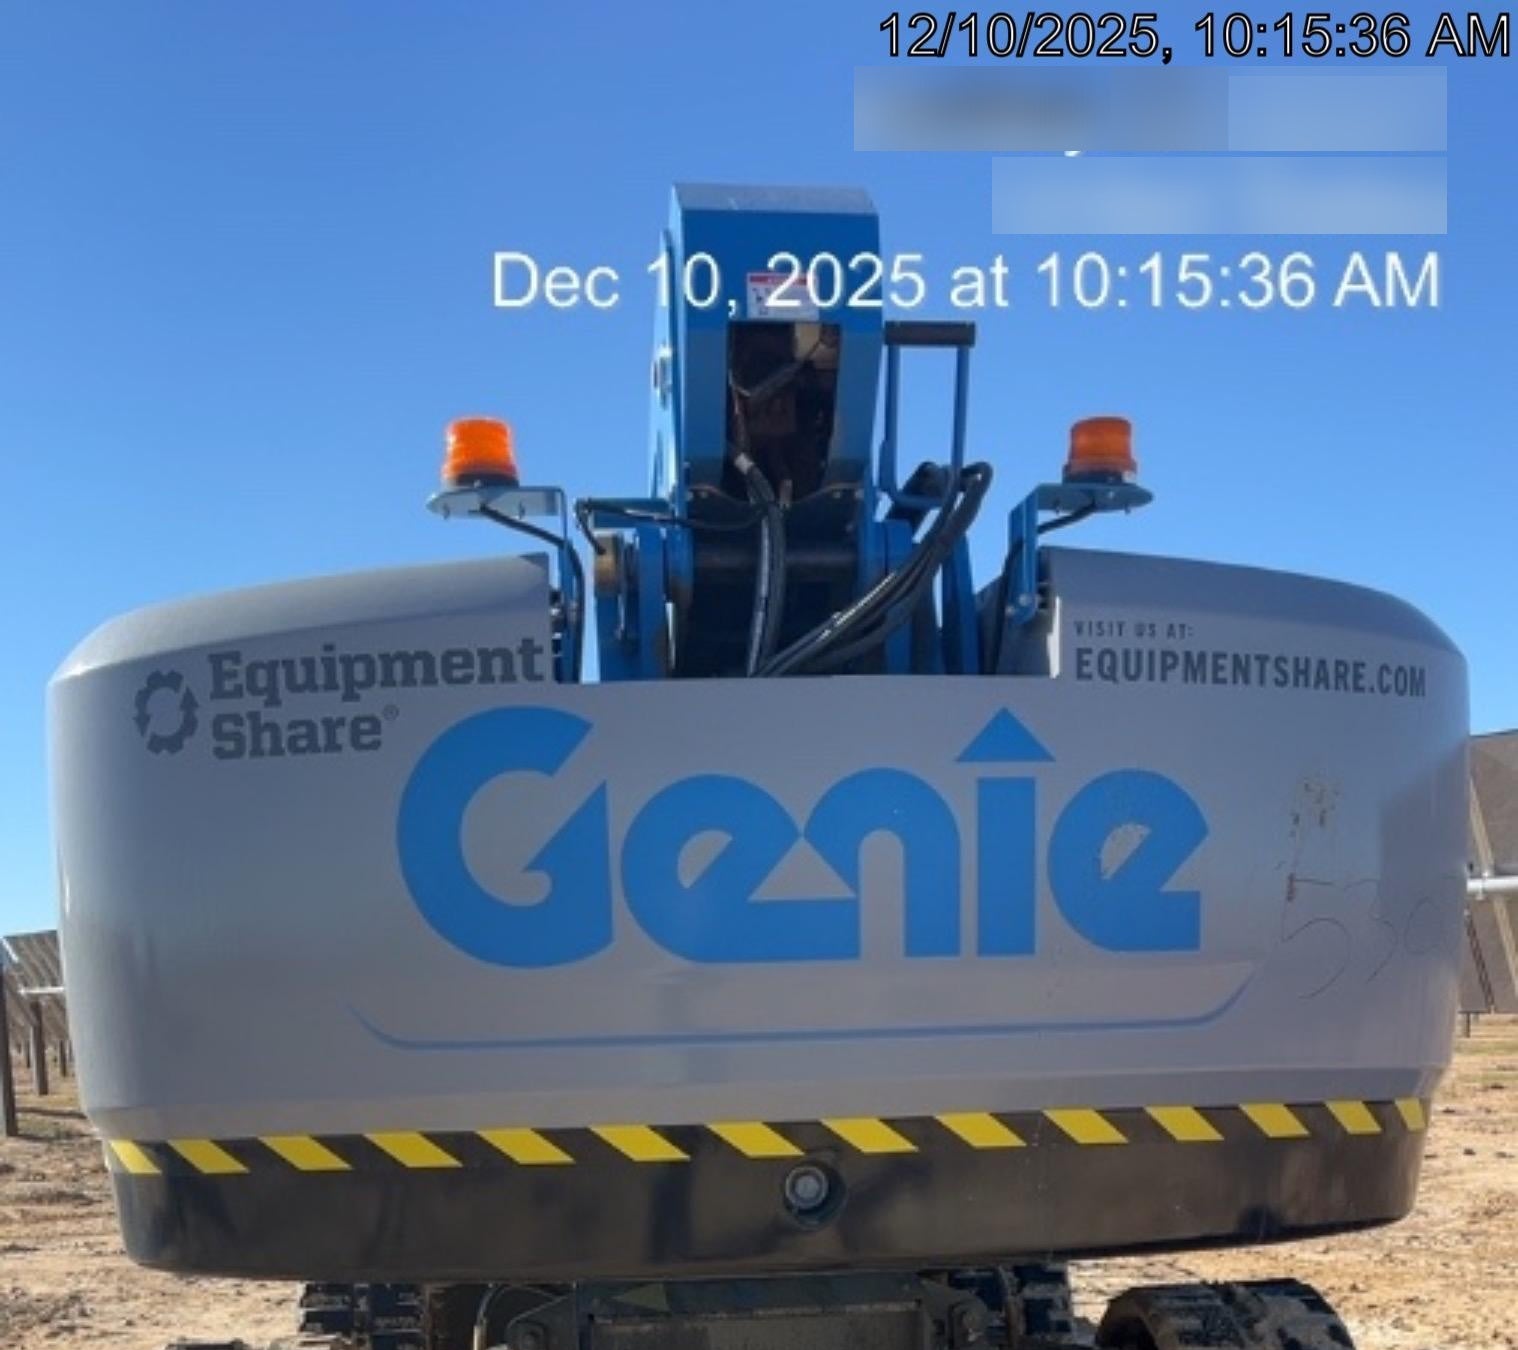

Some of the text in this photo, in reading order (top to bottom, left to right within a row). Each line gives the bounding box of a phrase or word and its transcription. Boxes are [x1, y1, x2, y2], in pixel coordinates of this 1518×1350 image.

[1074, 620, 1194, 640] VISIT US AT:
[208, 638, 545, 708] Equipment
[1075, 647, 1427, 697] EQUIPMENTSHARE.COM
[396, 705, 1209, 968] Genie
